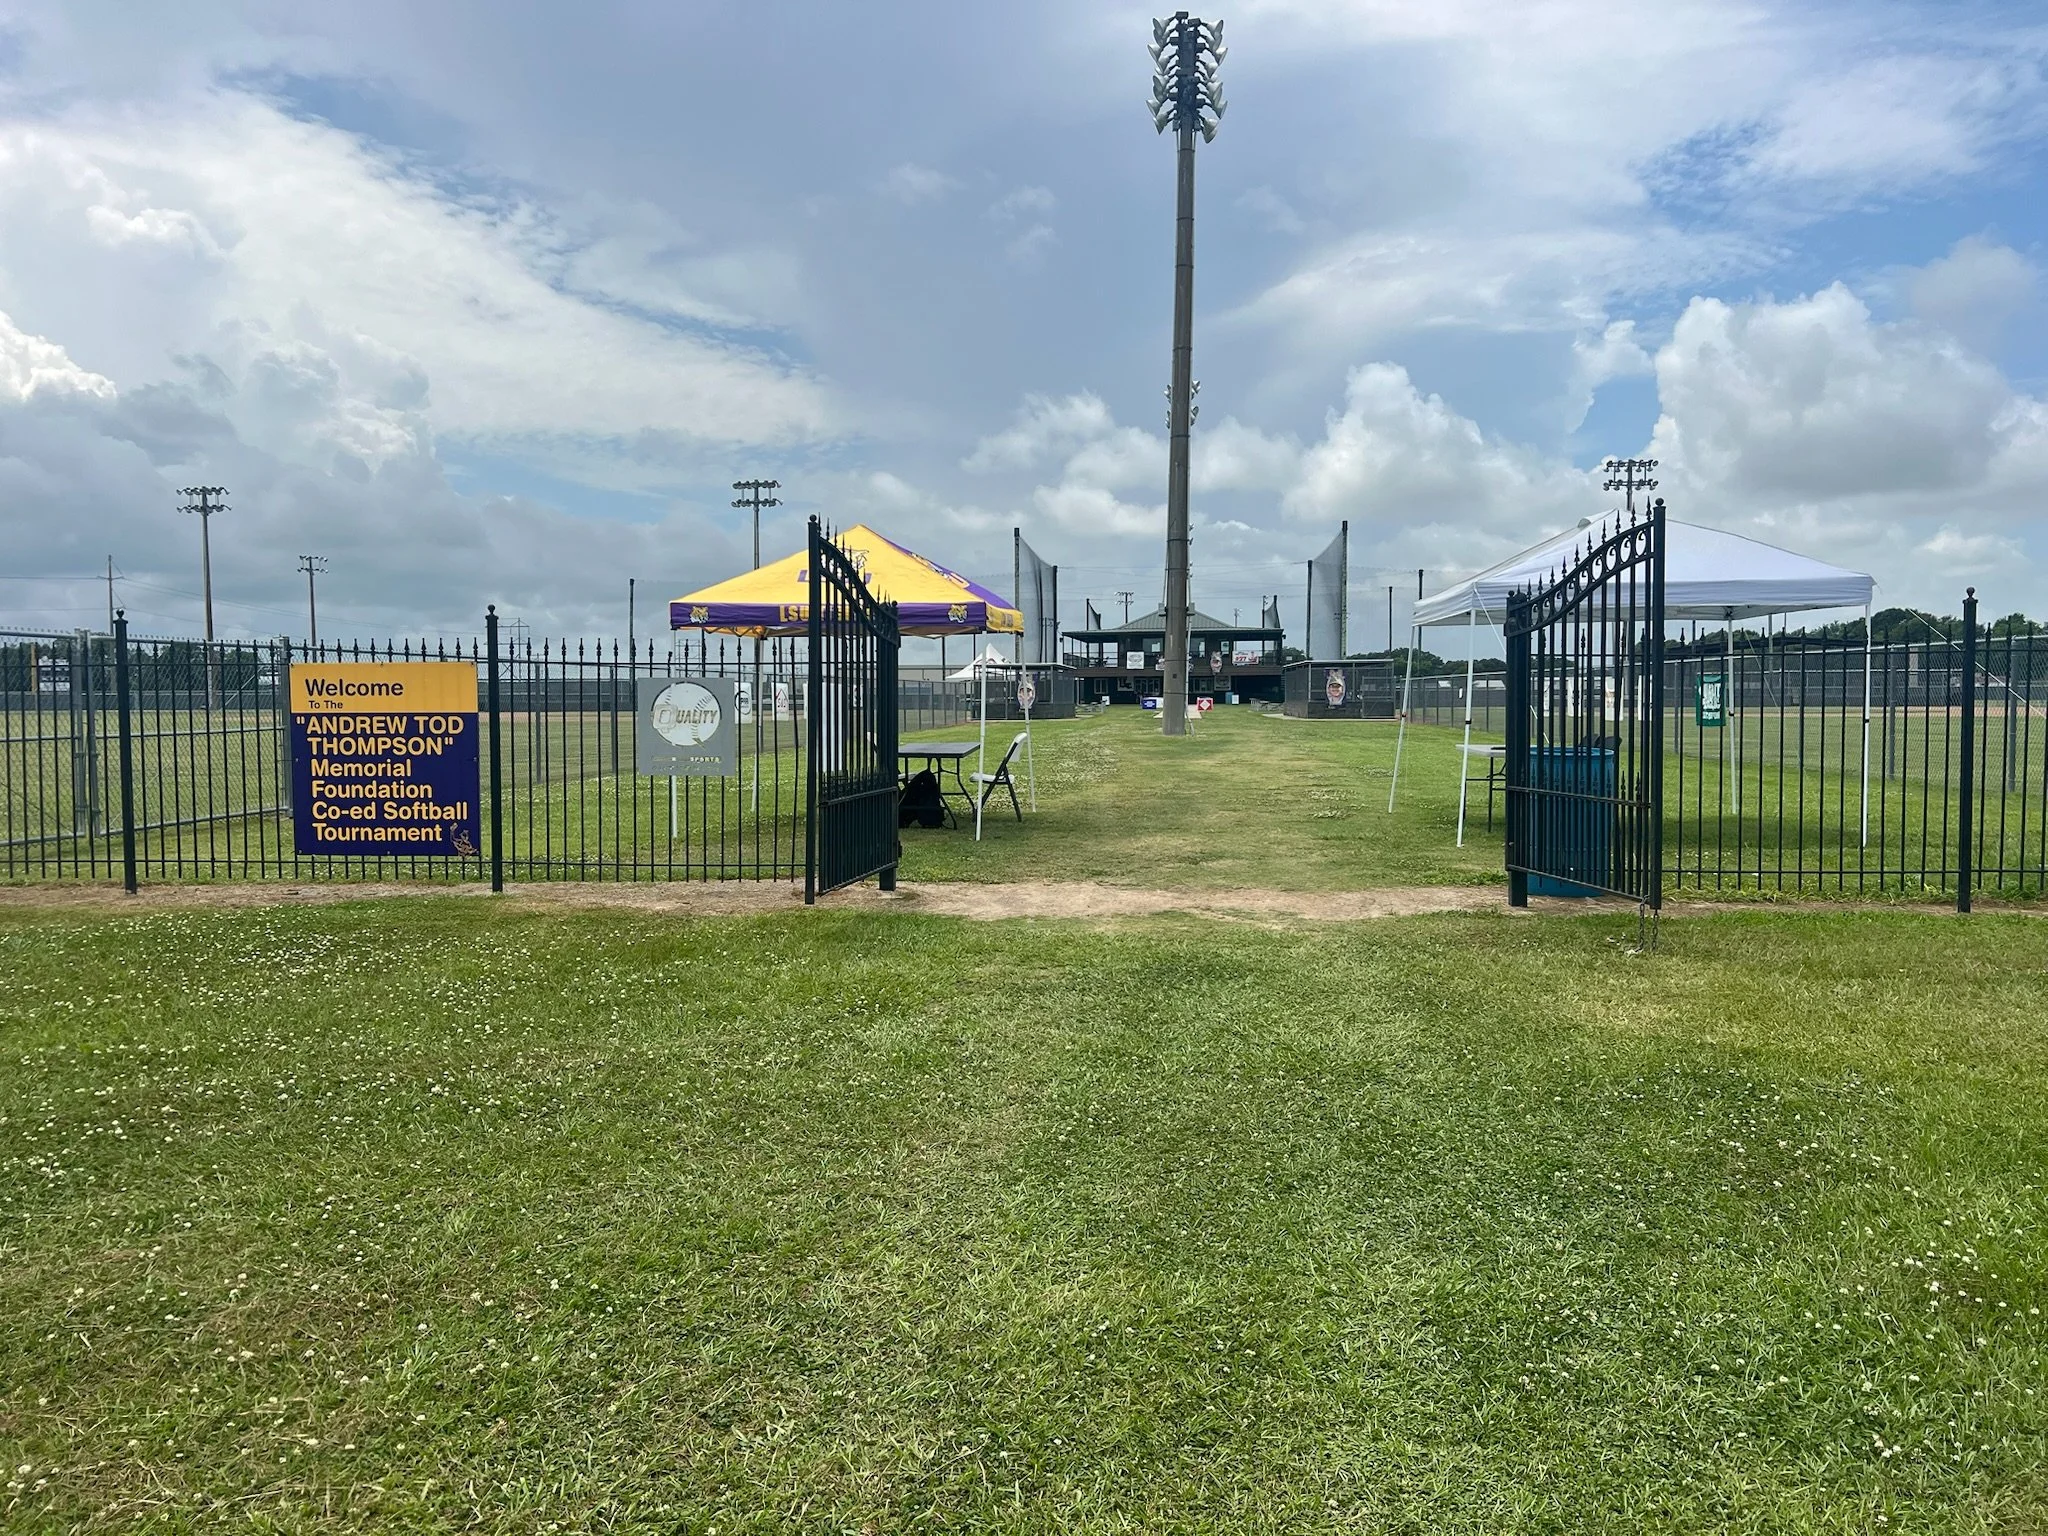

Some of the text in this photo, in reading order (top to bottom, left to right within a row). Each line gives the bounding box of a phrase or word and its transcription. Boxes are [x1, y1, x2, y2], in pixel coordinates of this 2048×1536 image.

[305, 678, 404, 696] Welcome
[308, 700, 343, 709] To The
[296, 715, 465, 735] "ANDREW TOD
[653, 704, 718, 733] QUALITY
[306, 736, 454, 756] THOMPSON"
[311, 758, 412, 777] Memorial
[311, 780, 433, 799] Foundation
[312, 801, 469, 820] Co-ed Softball
[312, 822, 443, 842] Tournament
